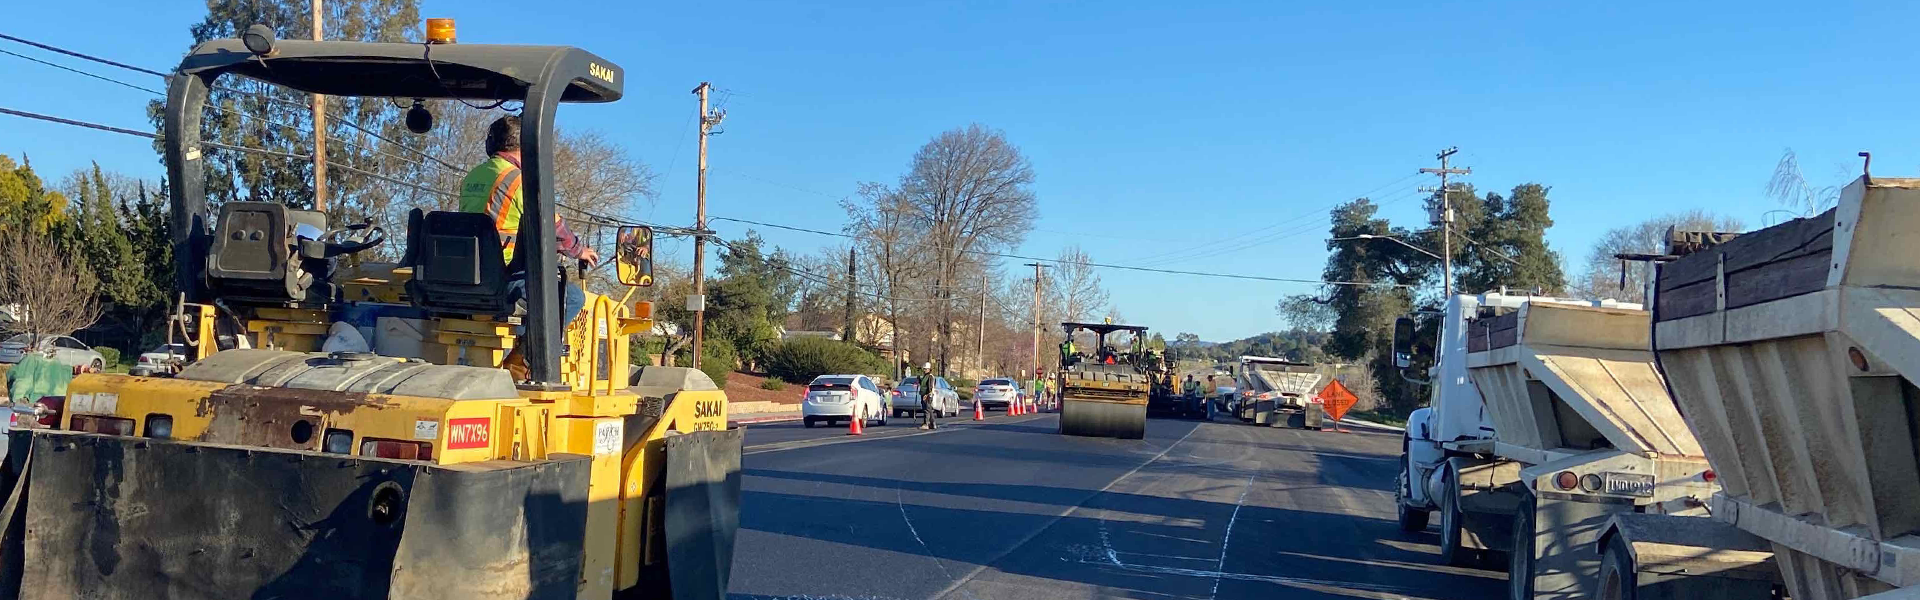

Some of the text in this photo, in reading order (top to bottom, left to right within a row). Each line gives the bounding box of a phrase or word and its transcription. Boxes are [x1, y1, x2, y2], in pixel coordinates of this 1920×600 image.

[590, 62, 614, 83] SAKAI
[694, 400, 722, 418] SAKAI
[1324, 399, 1349, 408] CLOSED
[450, 424, 488, 443] WN7X96
